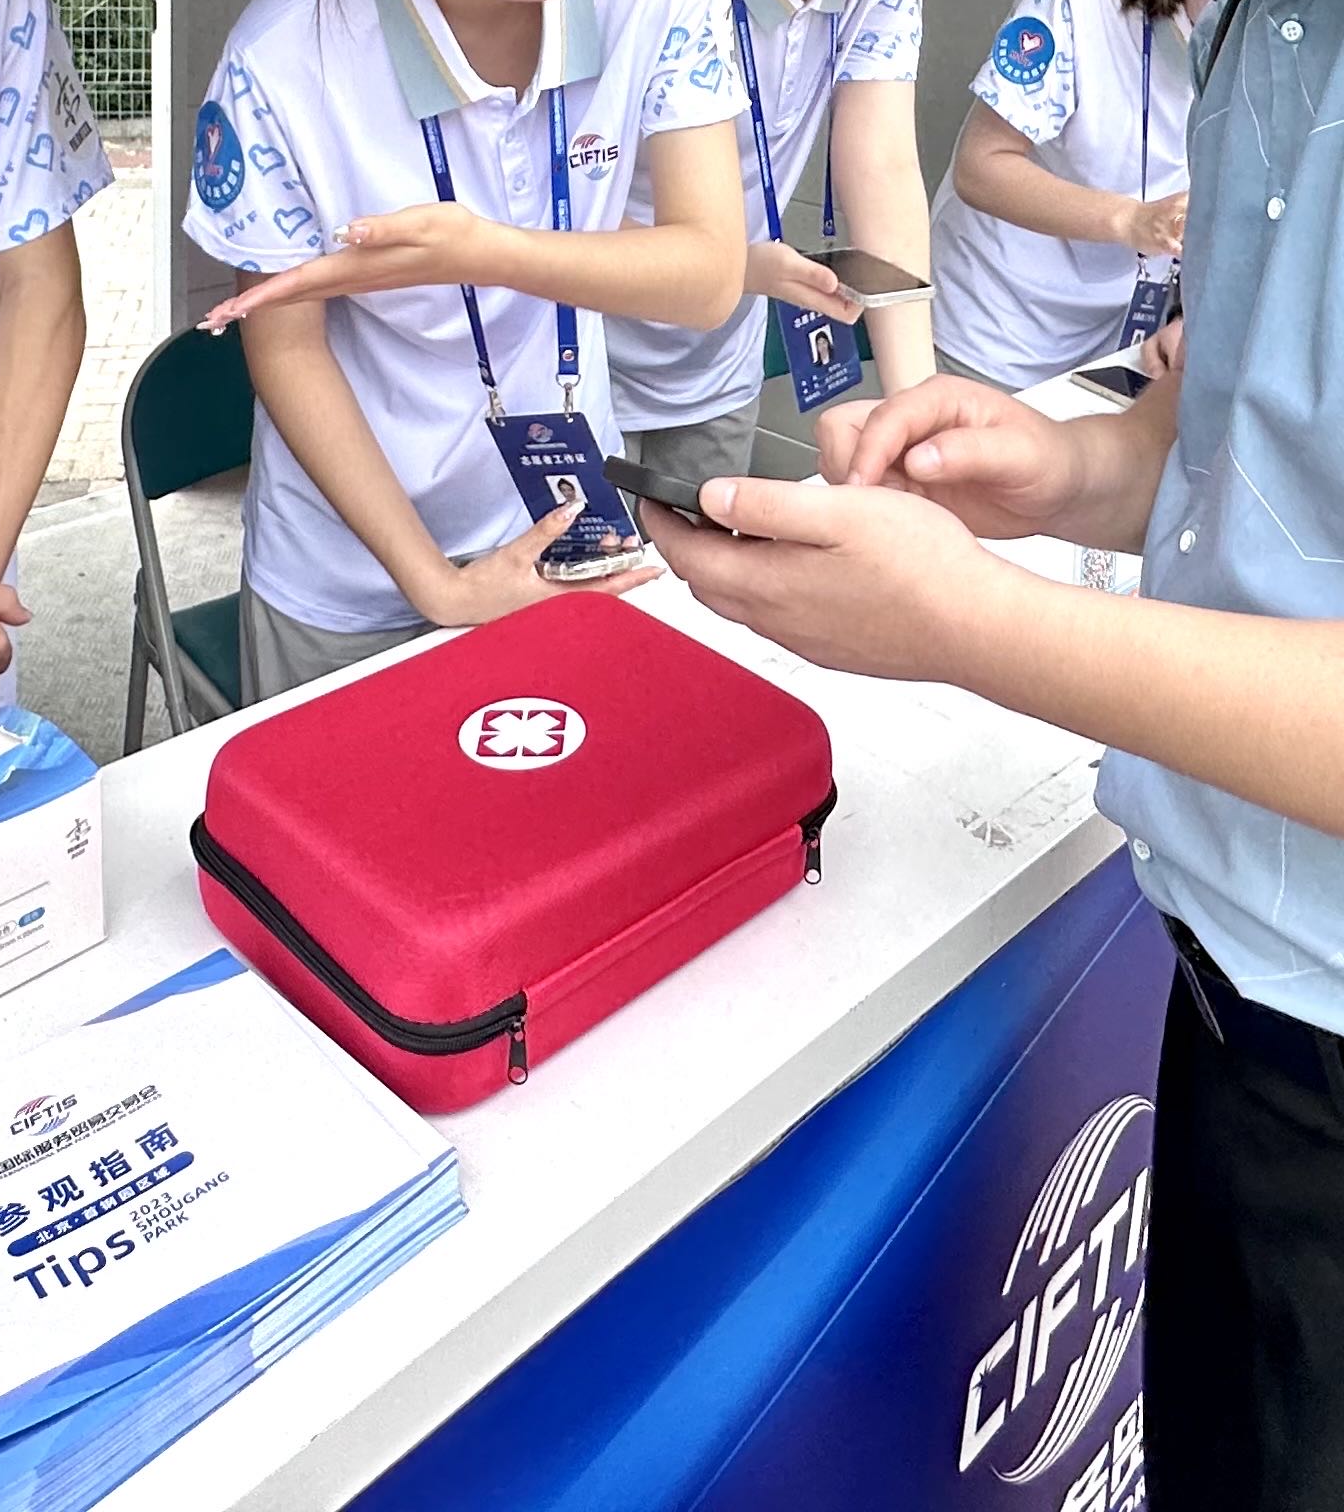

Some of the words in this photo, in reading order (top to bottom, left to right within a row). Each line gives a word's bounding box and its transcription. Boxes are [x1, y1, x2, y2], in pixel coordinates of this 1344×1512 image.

[568, 144, 620, 170] CIFTIS
[10, 1093, 78, 1136] CIFTIS
[129, 1191, 174, 1223] 2023
[135, 1170, 232, 1233] SHOUGANG
[143, 1210, 190, 1244] PARK
[12, 1228, 137, 1300] Tips
[959, 1167, 1151, 1473] CIFTI
